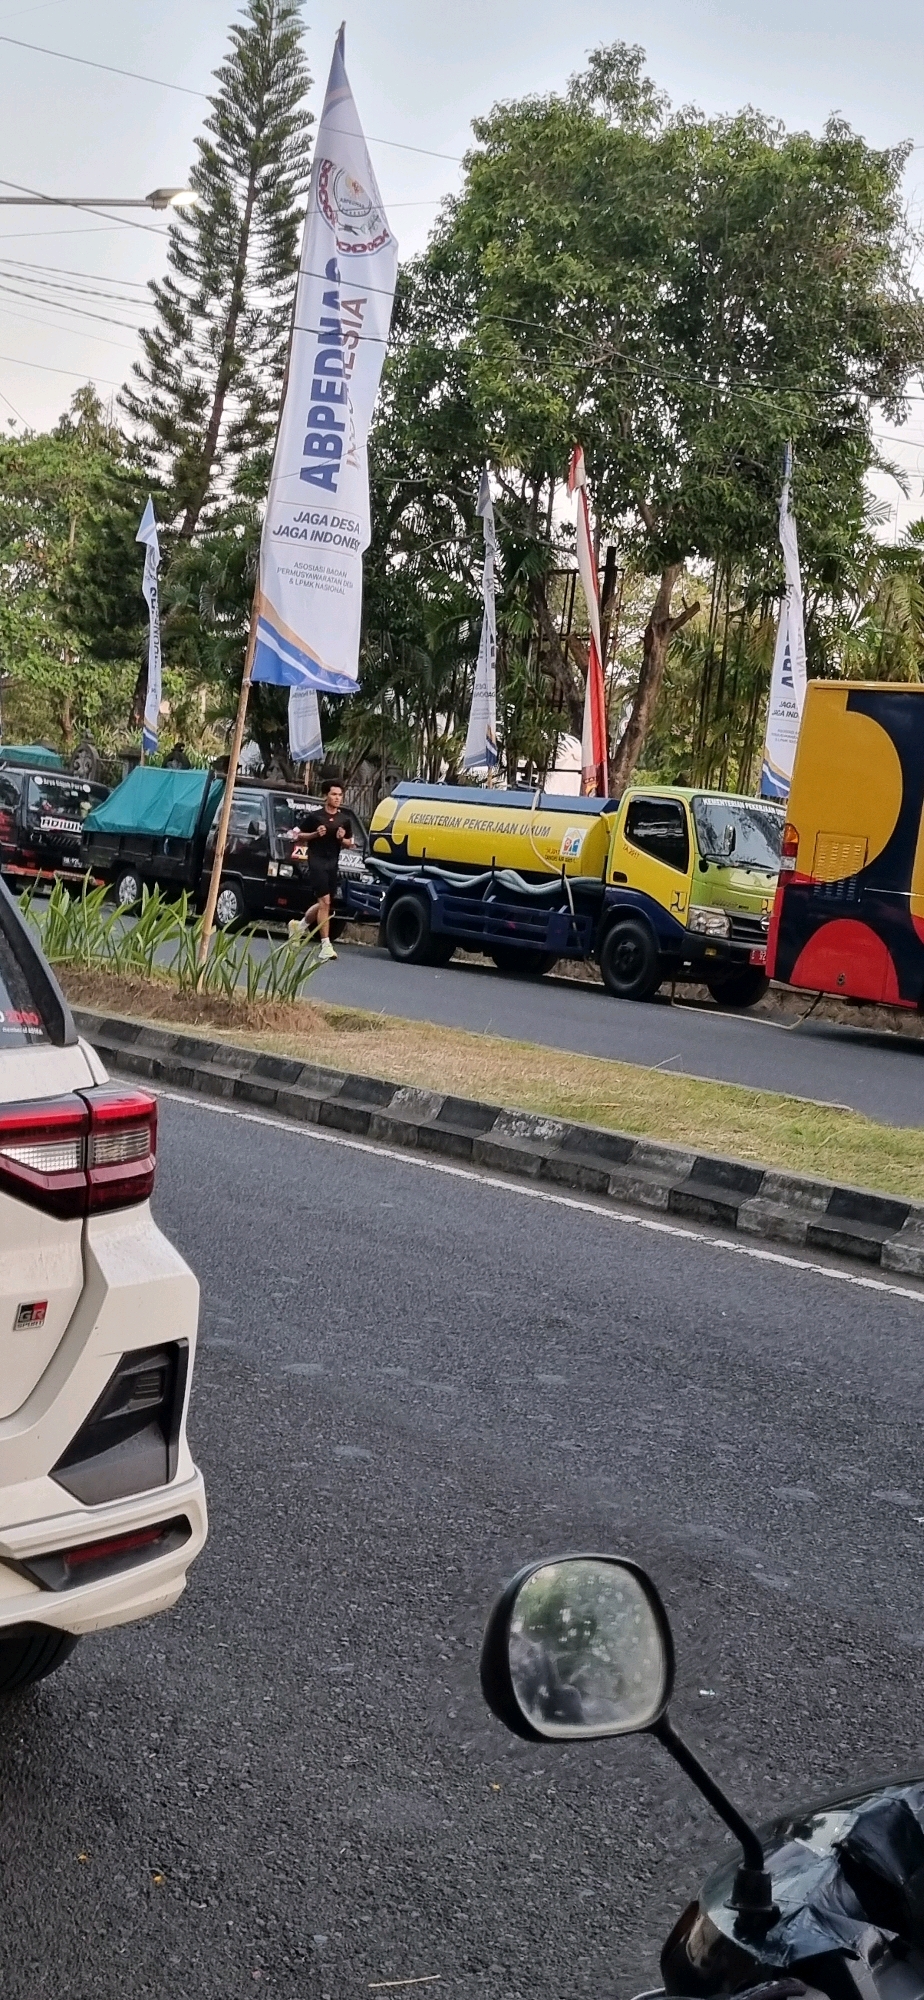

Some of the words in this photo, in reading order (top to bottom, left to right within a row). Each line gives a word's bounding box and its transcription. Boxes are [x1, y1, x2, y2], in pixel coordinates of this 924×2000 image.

[293, 511, 328, 526] JAGA
[330, 516, 360, 534] DESA
[272, 525, 308, 540] JAGA
[294, 561, 325, 572] ASOSIASI
[326, 567, 348, 578] BADAN
[295, 578, 315, 588] LPMK
[408, 812, 463, 828] KEMENTERIAN
[462, 818, 519, 834] PEKERJAAN
[20, 1309, 46, 1322] GR
